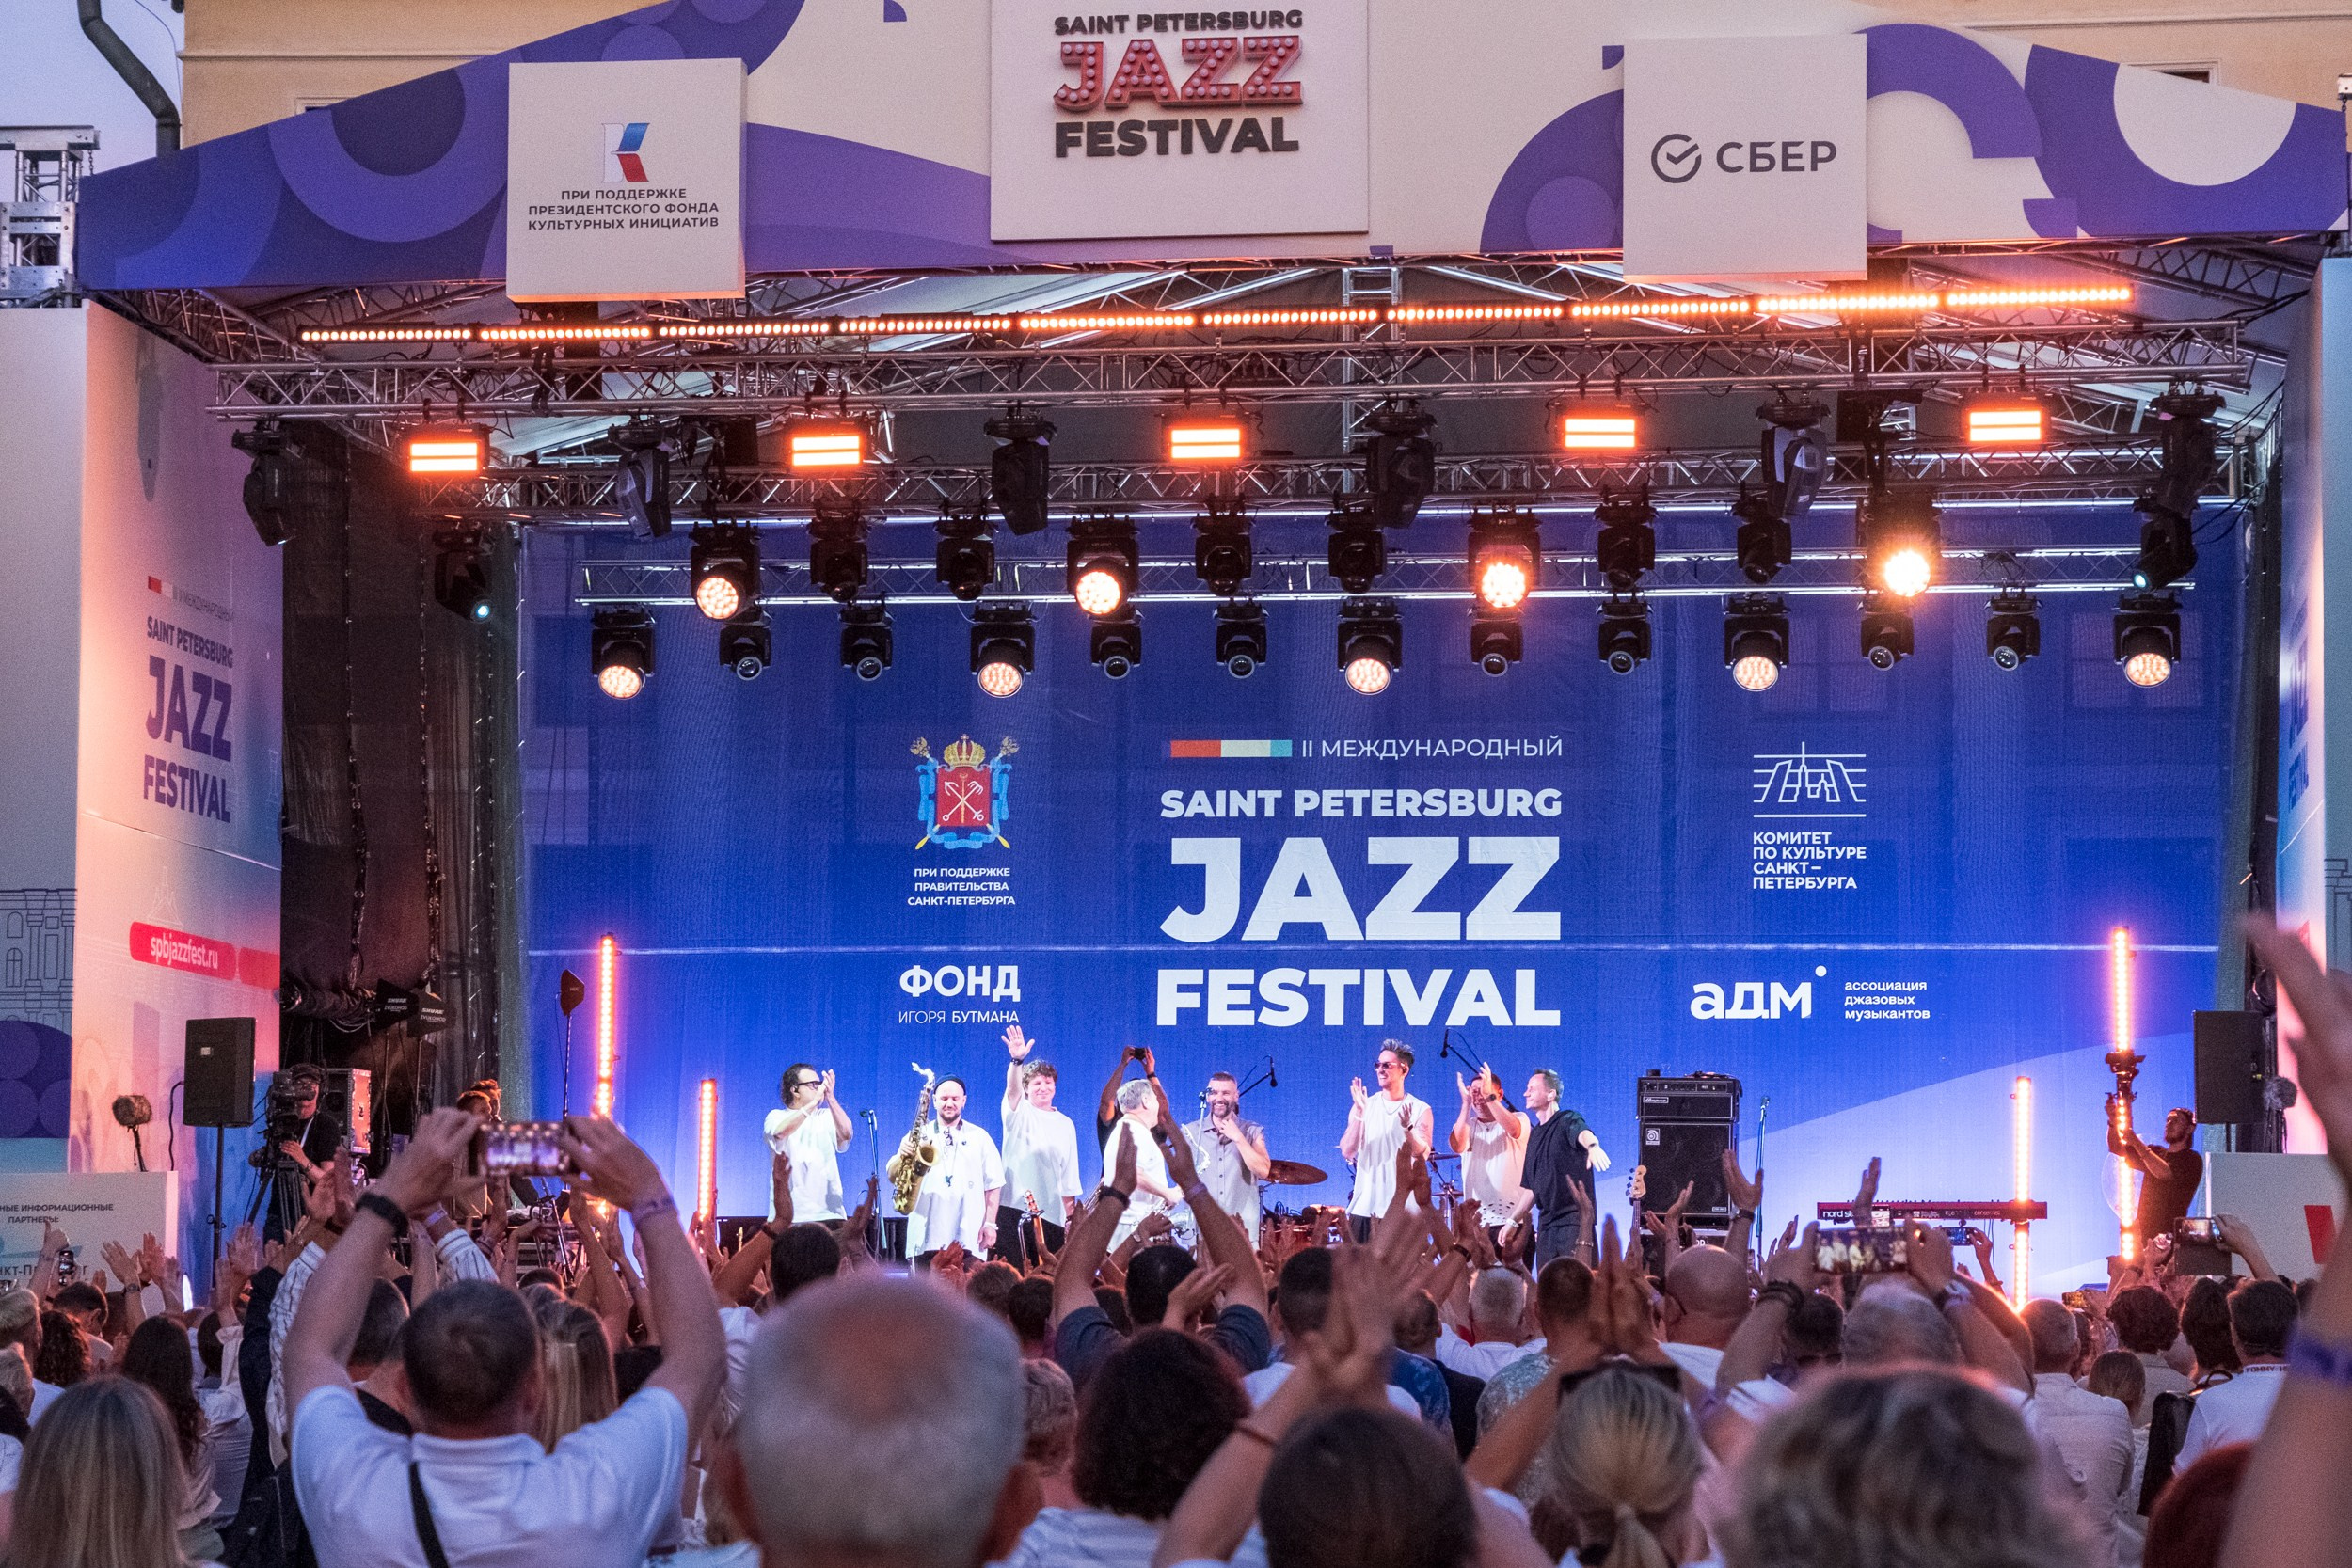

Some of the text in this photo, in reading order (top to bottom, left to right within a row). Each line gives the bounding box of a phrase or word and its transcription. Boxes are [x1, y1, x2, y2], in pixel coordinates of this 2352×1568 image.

[1054, 9, 1303, 36] SAINT PETERSBURG
[1053, 35, 1303, 112] JAZZ
[1055, 116, 1300, 158] FESTIVAL
[1716, 140, 1837, 174] СБЕР
[561, 188, 687, 201] ПРИ ПОДДЕРЖКЕ
[529, 202, 719, 216] ПРЕЗИДЕНТСКОГО ФОНДА
[528, 217, 719, 230] КУЛЬТУРНЫХ ИНИЦИАТИВ
[147, 615, 233, 669] SAINT PETERSBURG
[145, 654, 232, 763] JAZZ
[1322, 736, 1563, 760] МЕЖДУНАРОДНЫЙ
[143, 753, 230, 823] FESTIVAL
[1160, 788, 1562, 818] SAINT PETERSBURG
[1753, 832, 1832, 845] КОМИТЕТ
[1753, 847, 1867, 860] ПО КУЛЬТУРЕ
[914, 867, 1010, 879] ПРИ ПОДДЕРЖКЕ
[914, 881, 1009, 892] ПРАВИТЕЛЬСТВА
[1753, 876, 1857, 889] ПЕТЕРБУРГА
[1159, 836, 1561, 943] JAZZ
[907, 895, 1016, 906] САНКТ-ПЕТЕРБУРГА
[151, 932, 218, 969] spbjazzfest.ru
[899, 964, 1021, 1002] ФОНД
[1844, 981, 1928, 993] ассоциация
[1156, 967, 1561, 1027] FESTIVAL
[1844, 995, 1915, 1006] джазовых
[898, 1010, 1020, 1023] ИГОРЯ БУТМАНА
[1844, 1009, 1931, 1022] музыкантов
[21, 1203, 114, 1212] ИНФОРМАЦИОННЫЕ
[1822, 1210, 1844, 1218] nord
